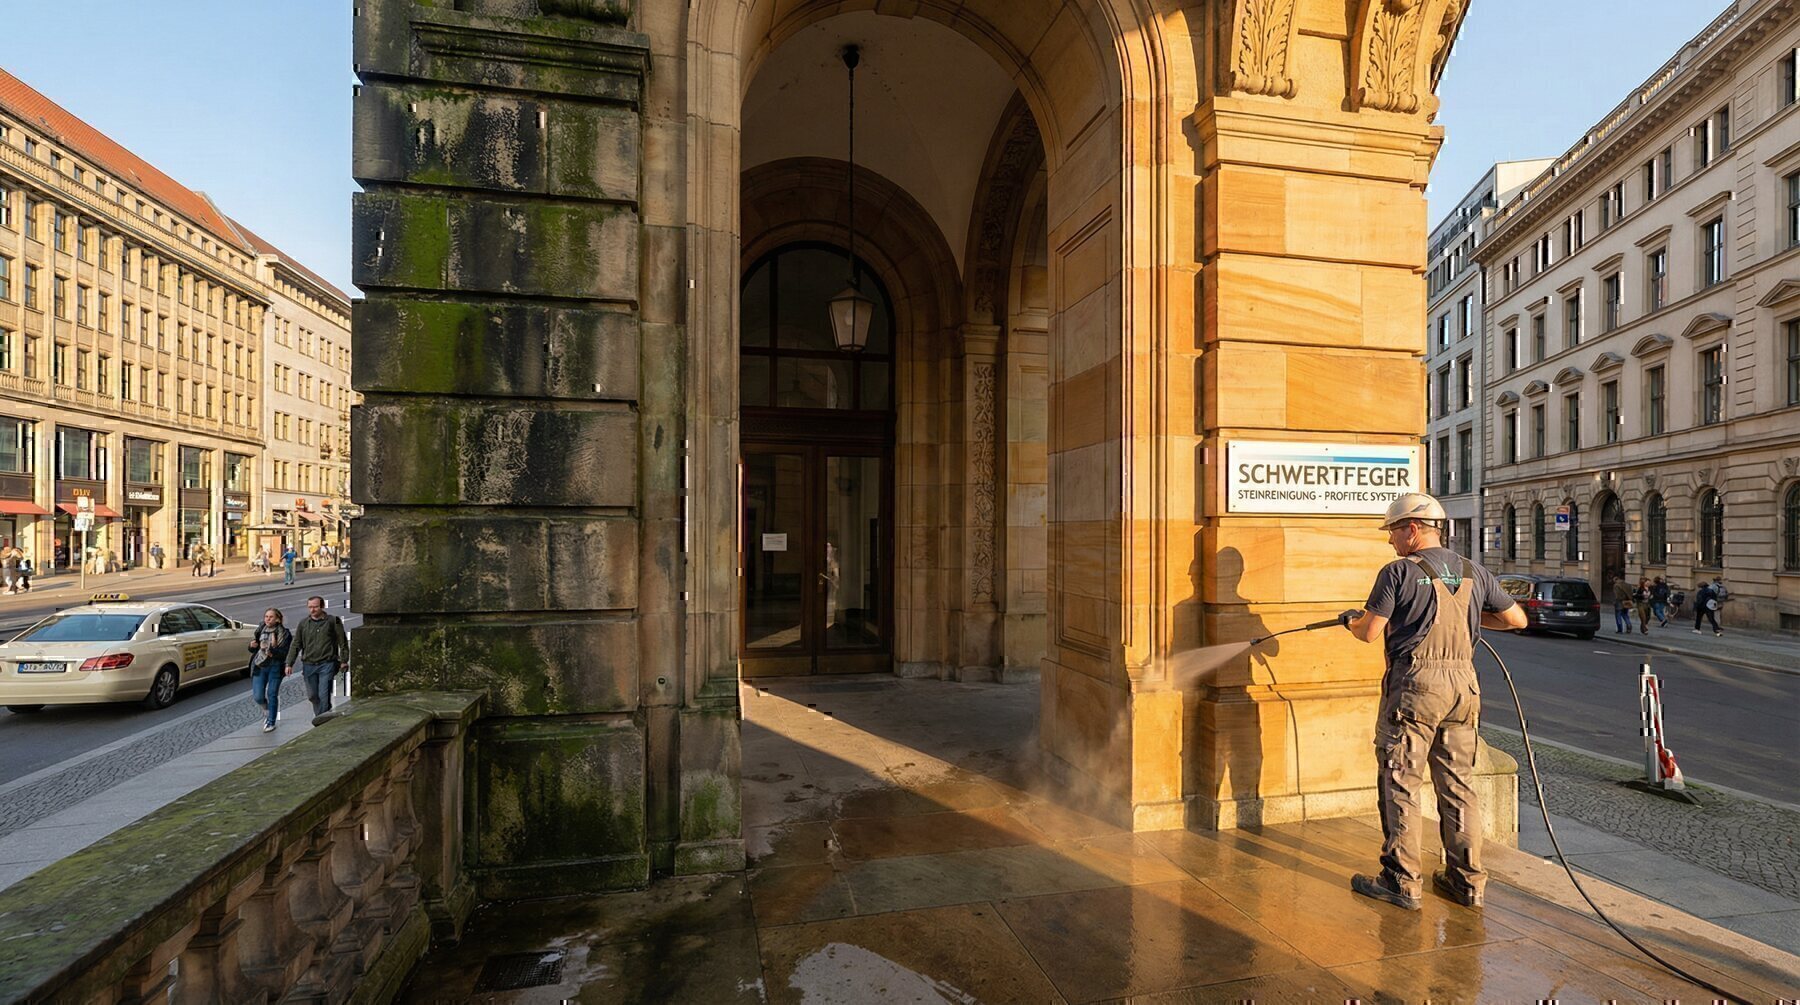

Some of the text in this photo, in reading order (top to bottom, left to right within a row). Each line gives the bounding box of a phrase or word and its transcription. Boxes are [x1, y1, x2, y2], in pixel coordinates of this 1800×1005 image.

[1238, 463, 1410, 487] SCHWERTFEGER
[1238, 489, 1316, 500] STEINREINIGUNG
[1324, 491, 1369, 502] PROFITEC
